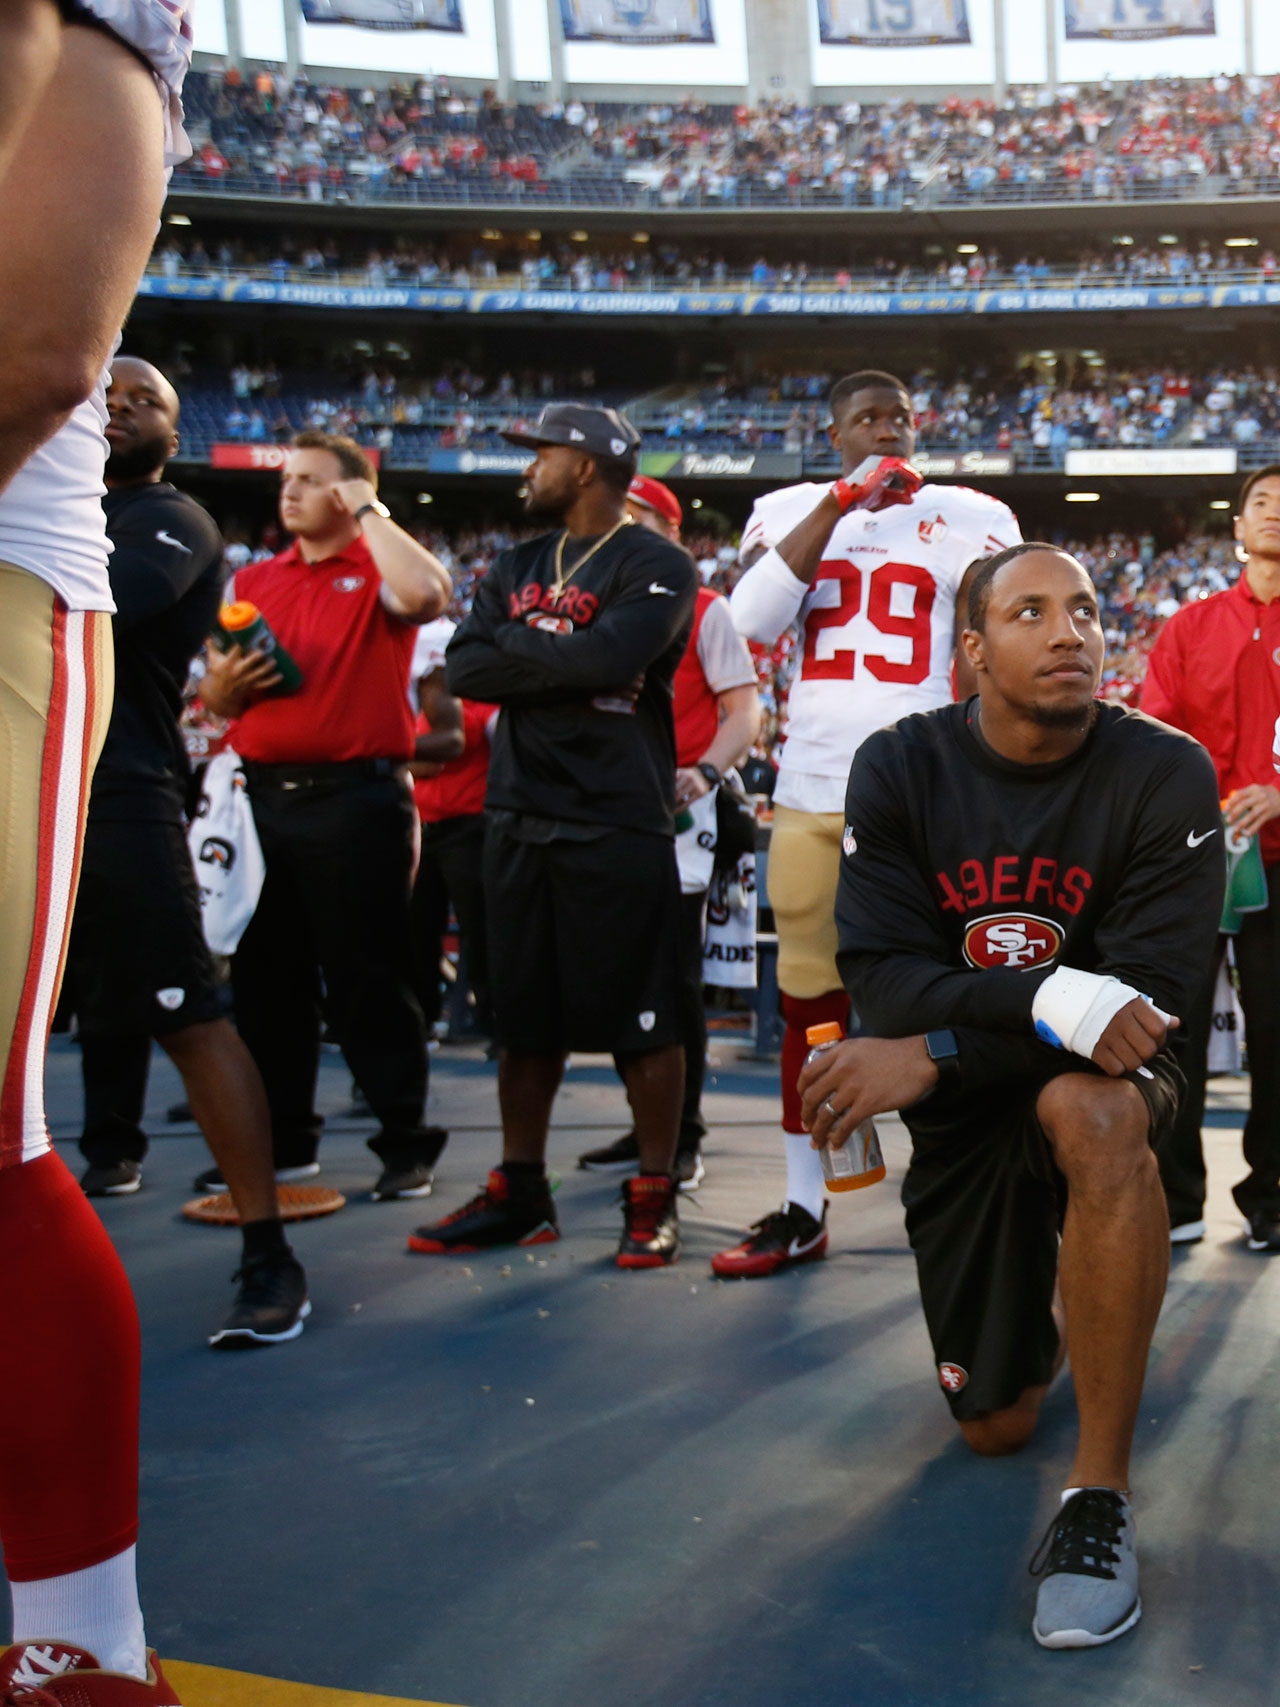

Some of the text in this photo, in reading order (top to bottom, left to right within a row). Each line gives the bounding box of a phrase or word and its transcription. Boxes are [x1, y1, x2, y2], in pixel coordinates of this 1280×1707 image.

[281, 286, 348, 306] CHUCK
[350, 290, 409, 306] ALLEN
[525, 293, 579, 311] GARY
[579, 294, 681, 313] GARRISON
[802, 295, 892, 313] GILLMAN
[683, 453, 756, 475] FanDuel
[801, 560, 937, 685] 29
[936, 855, 1093, 916] 49ERS
